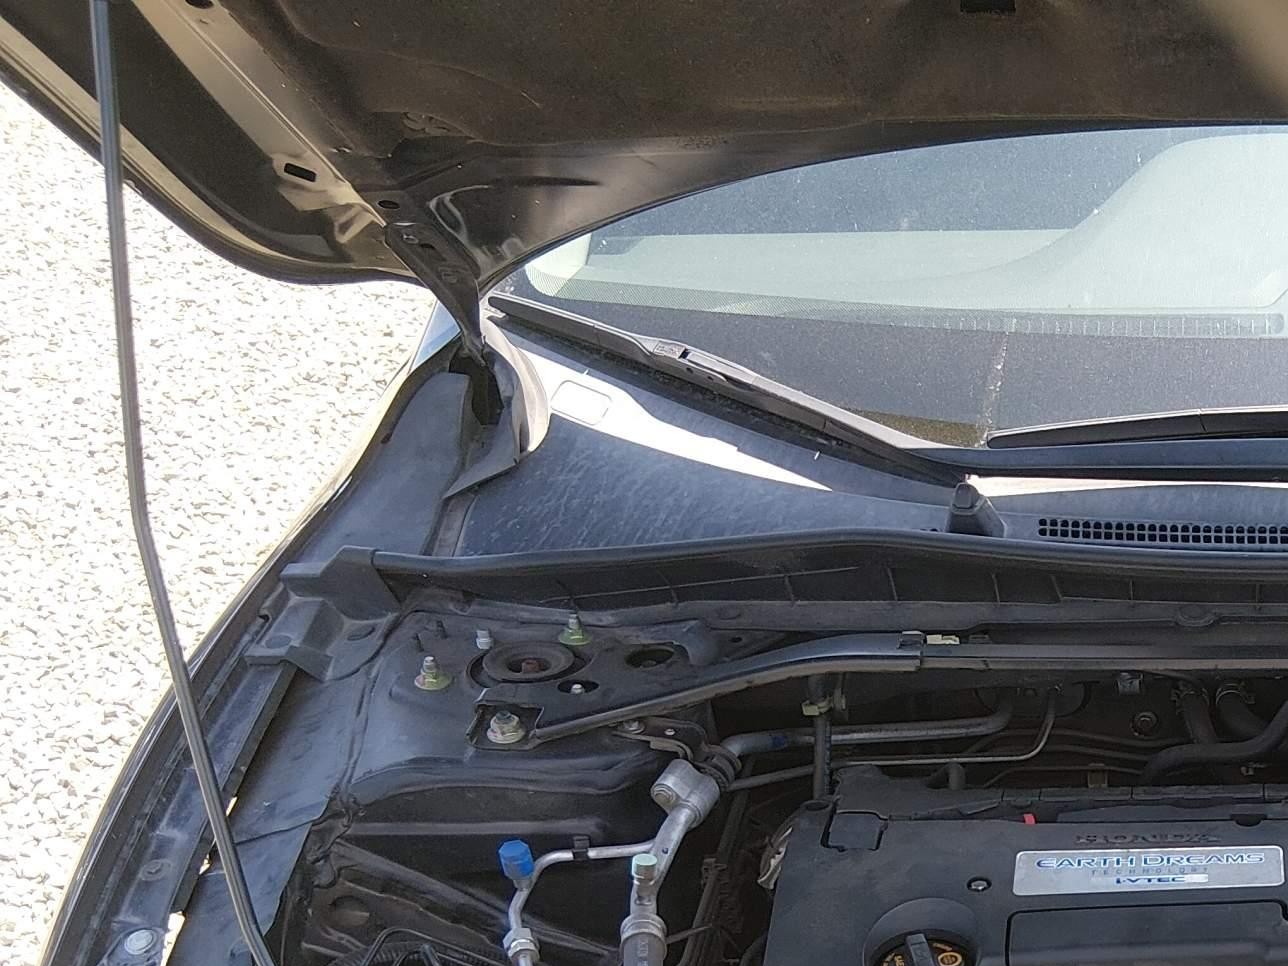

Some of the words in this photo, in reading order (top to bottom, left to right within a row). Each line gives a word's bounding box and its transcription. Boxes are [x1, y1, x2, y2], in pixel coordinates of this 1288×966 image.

[1036, 856, 1134, 869] EARTH
[1142, 853, 1265, 866] DREAMS
[1091, 867, 1210, 876] TECHNOLOGY
